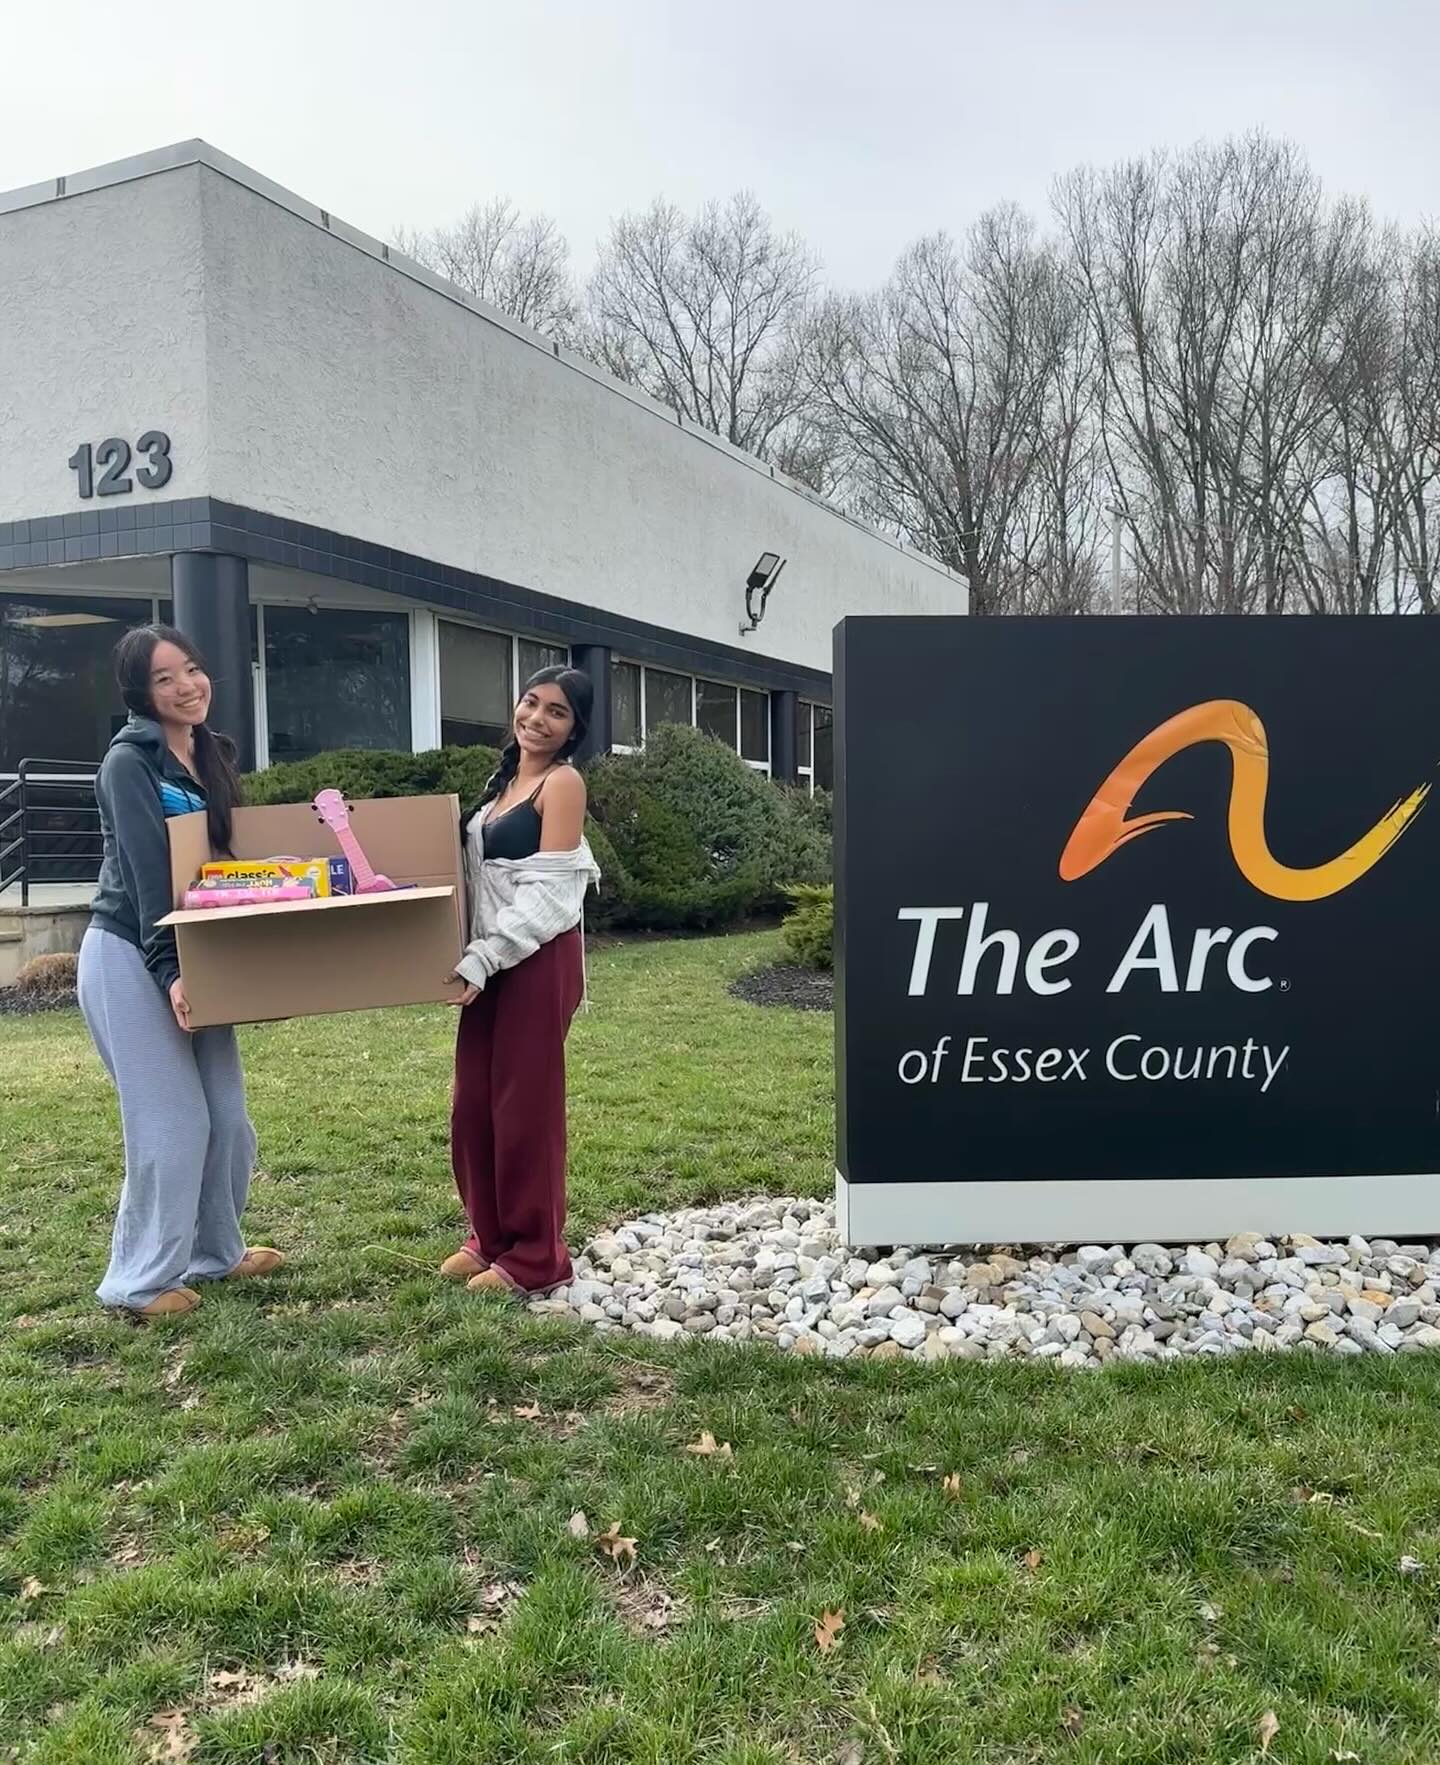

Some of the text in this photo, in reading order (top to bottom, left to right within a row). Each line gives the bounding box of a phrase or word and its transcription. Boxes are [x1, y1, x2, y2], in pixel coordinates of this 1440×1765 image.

[68, 430, 173, 499] 123
[897, 902, 1080, 996] The
[898, 1034, 1290, 1093] of Essex County
